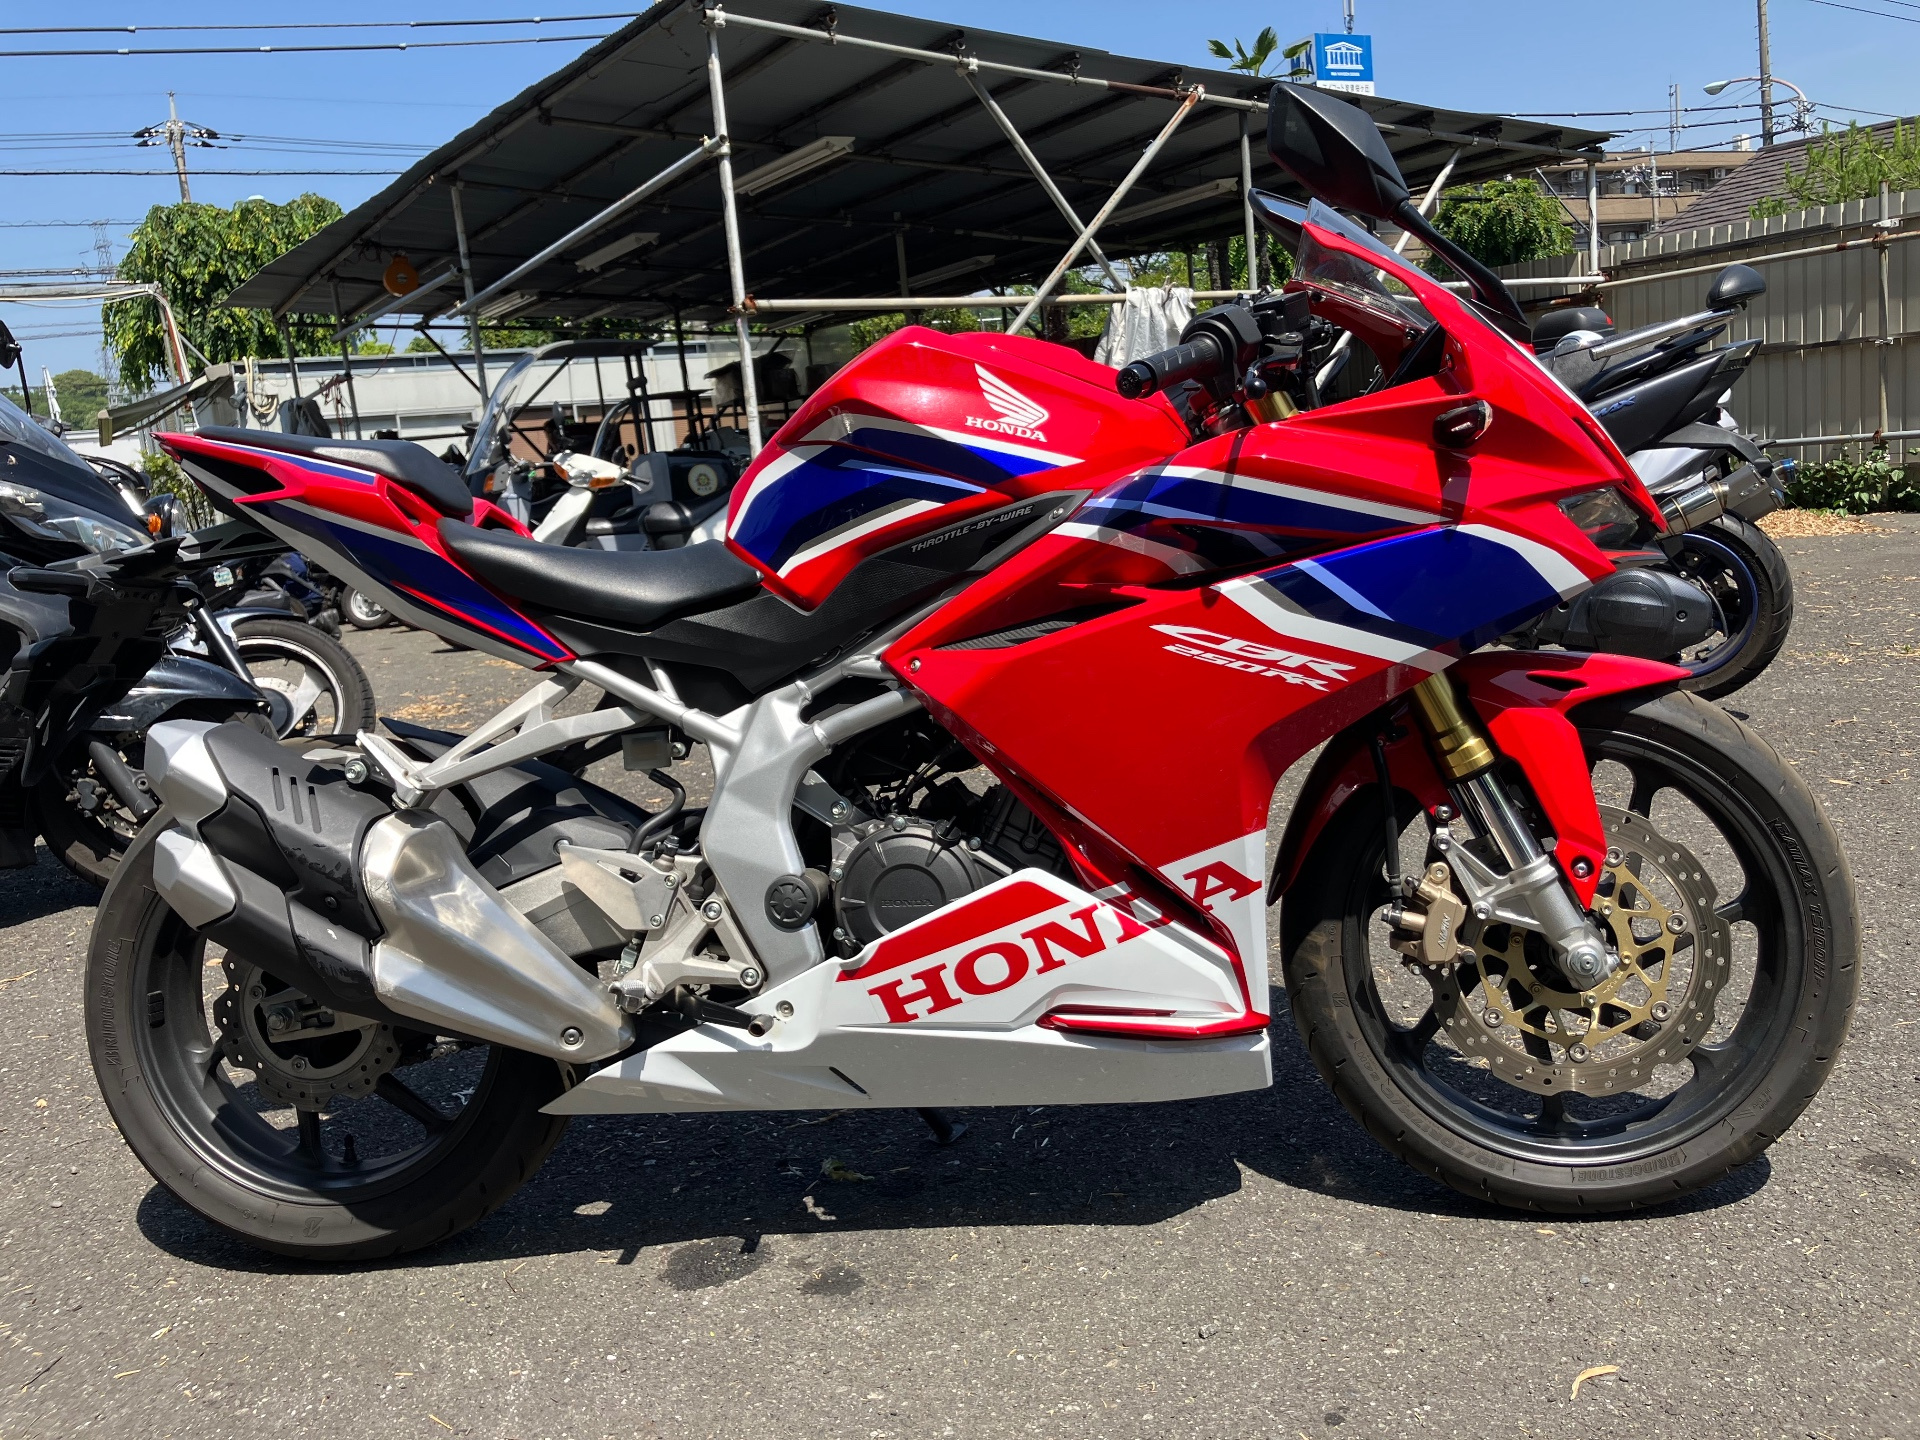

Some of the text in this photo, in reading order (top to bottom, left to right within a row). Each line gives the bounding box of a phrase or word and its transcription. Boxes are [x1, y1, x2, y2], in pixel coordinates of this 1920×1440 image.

[965, 415, 1047, 442] HONDA
[910, 505, 1033, 553] THROTTLE-BY-WIRE
[1149, 624, 1356, 682] CBR
[1162, 643, 1330, 692] 250RR
[881, 899, 935, 908] HONDA
[868, 861, 1262, 1023] HONDA
